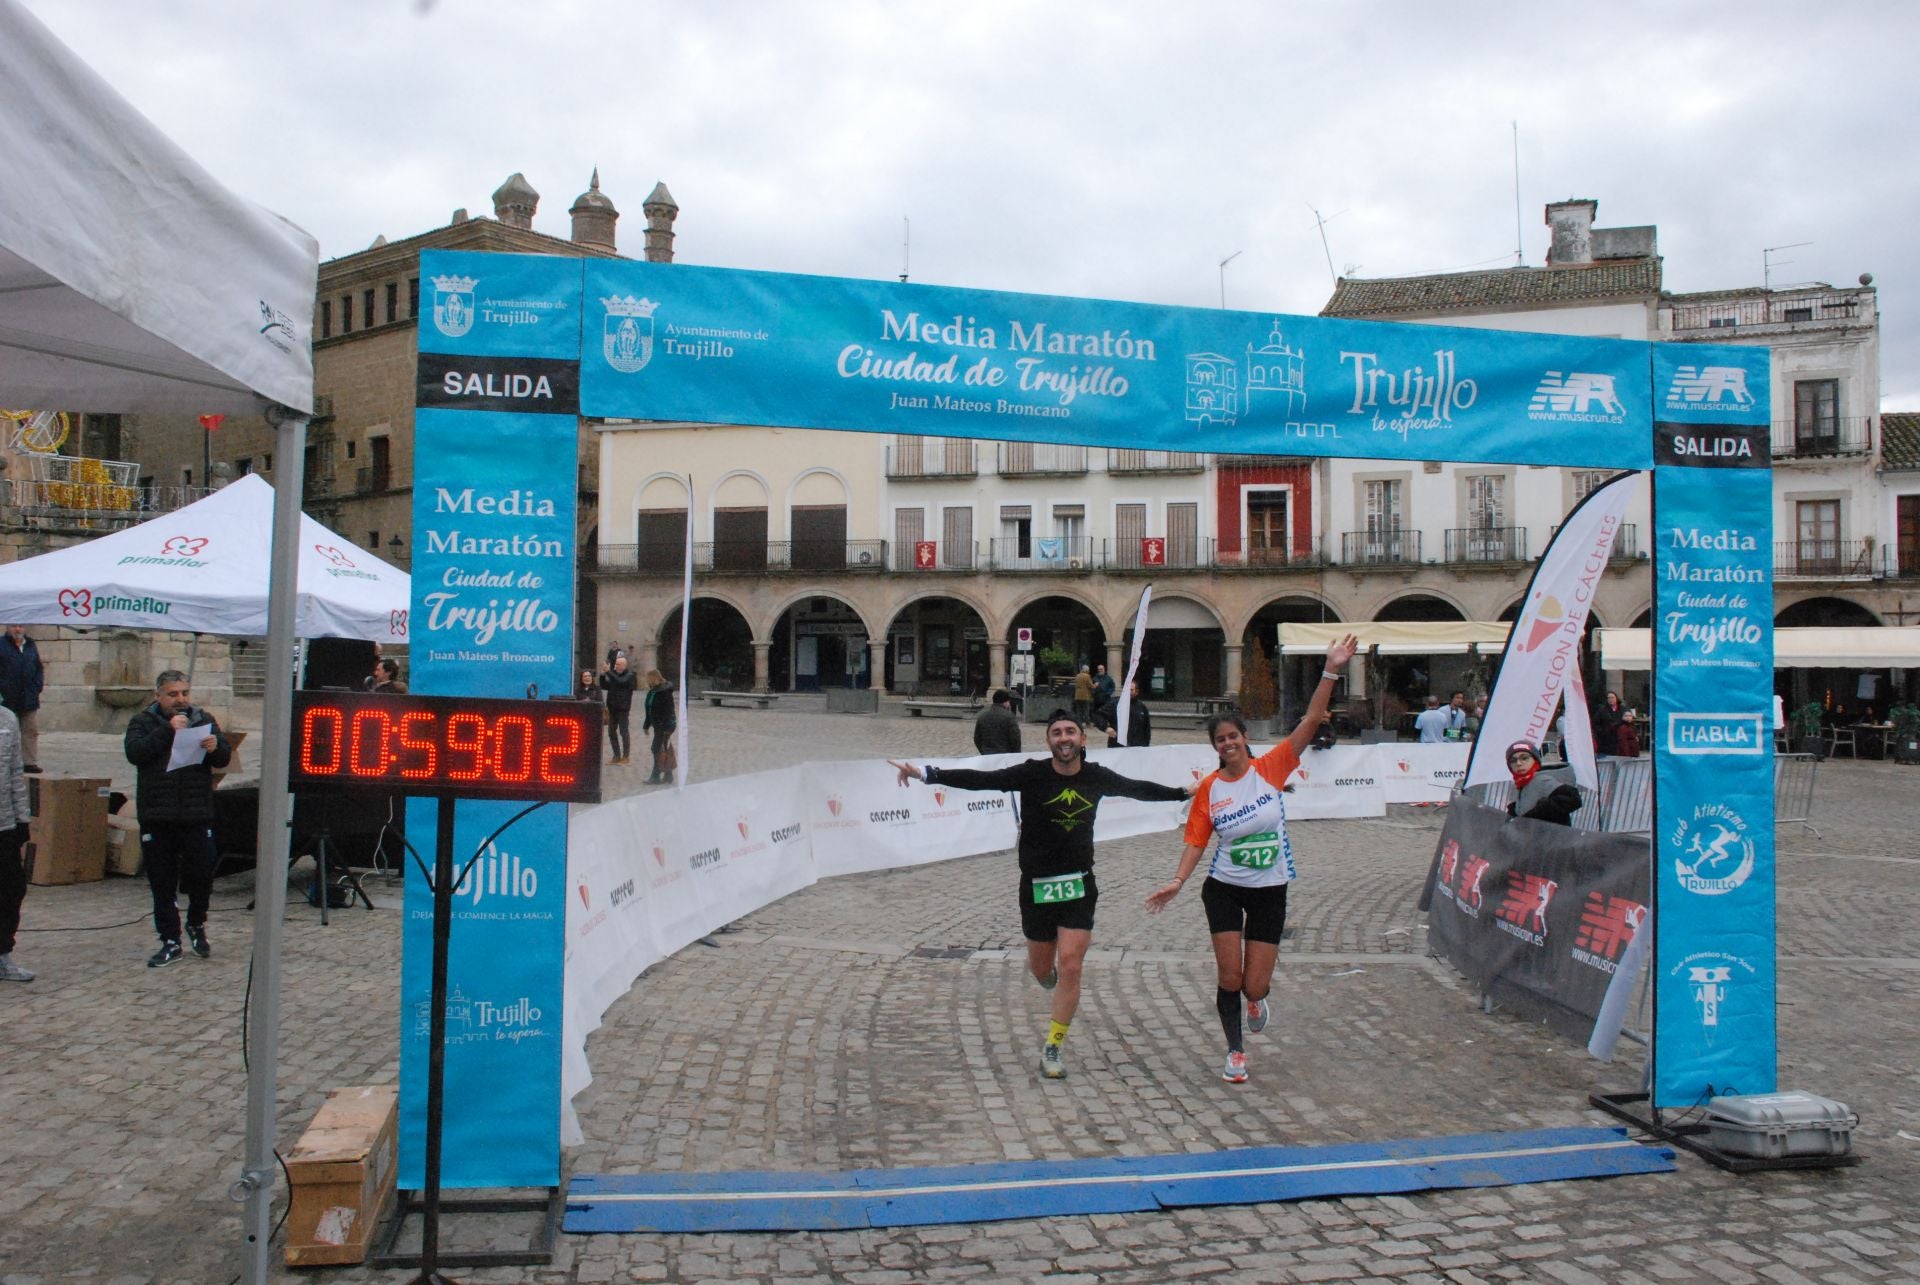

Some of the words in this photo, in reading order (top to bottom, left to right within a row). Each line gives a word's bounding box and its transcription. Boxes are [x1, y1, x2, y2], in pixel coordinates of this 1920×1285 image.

[483, 297, 553, 309] Ayuntamiento
[555, 300, 569, 310] de
[481, 309, 539, 327] Trujillo
[664, 322, 751, 340] Ayuntamiento
[754, 329, 769, 341] de
[881, 309, 996, 349] Media
[1009, 320, 1157, 361] Maratón
[662, 337, 734, 361] Trujillo
[443, 371, 553, 398] SALIDA
[837, 343, 957, 385] Ciudad
[955, 354, 1008, 387] de
[1015, 358, 1129, 405] Trujillo
[1339, 349, 1477, 421] Trujillo
[889, 392, 928, 410] Juan
[934, 394, 992, 413] Mateos
[996, 399, 1071, 418] Broncano
[1666, 402, 1751, 412] www.musicrun.es
[1371, 408, 1387, 431] te
[1527, 412, 1624, 424] www.musicrun.es
[1673, 435, 1752, 457] SALIDA
[434, 487, 556, 517] Media
[425, 530, 564, 558] Maratón
[1672, 527, 1757, 550] Media
[117, 554, 209, 569] primaflor
[1667, 562, 1764, 583] Maratón
[443, 567, 514, 588] Ciudad
[517, 571, 543, 589] de
[94, 595, 172, 615] primaflor
[1677, 592, 1726, 608] Ciudad
[1729, 594, 1748, 609] de
[424, 592, 558, 646] Trujillo
[1564, 610, 1582, 634] DE
[1665, 611, 1762, 654] Trujillo
[429, 650, 455, 661] Juan
[458, 650, 499, 662] Mateos
[502, 652, 555, 663] Broncano
[302, 708, 579, 782] 00:59:02
[1681, 726, 1749, 742] HABLA
[1256, 793, 1272, 807] 10k
[1671, 817, 1688, 847] Club
[1693, 803, 1747, 830] Atletismo
[1239, 848, 1272, 866] 212
[431, 836, 537, 906] ujillo
[1043, 882, 1075, 900] 213
[475, 998, 541, 1027] Trujillo
